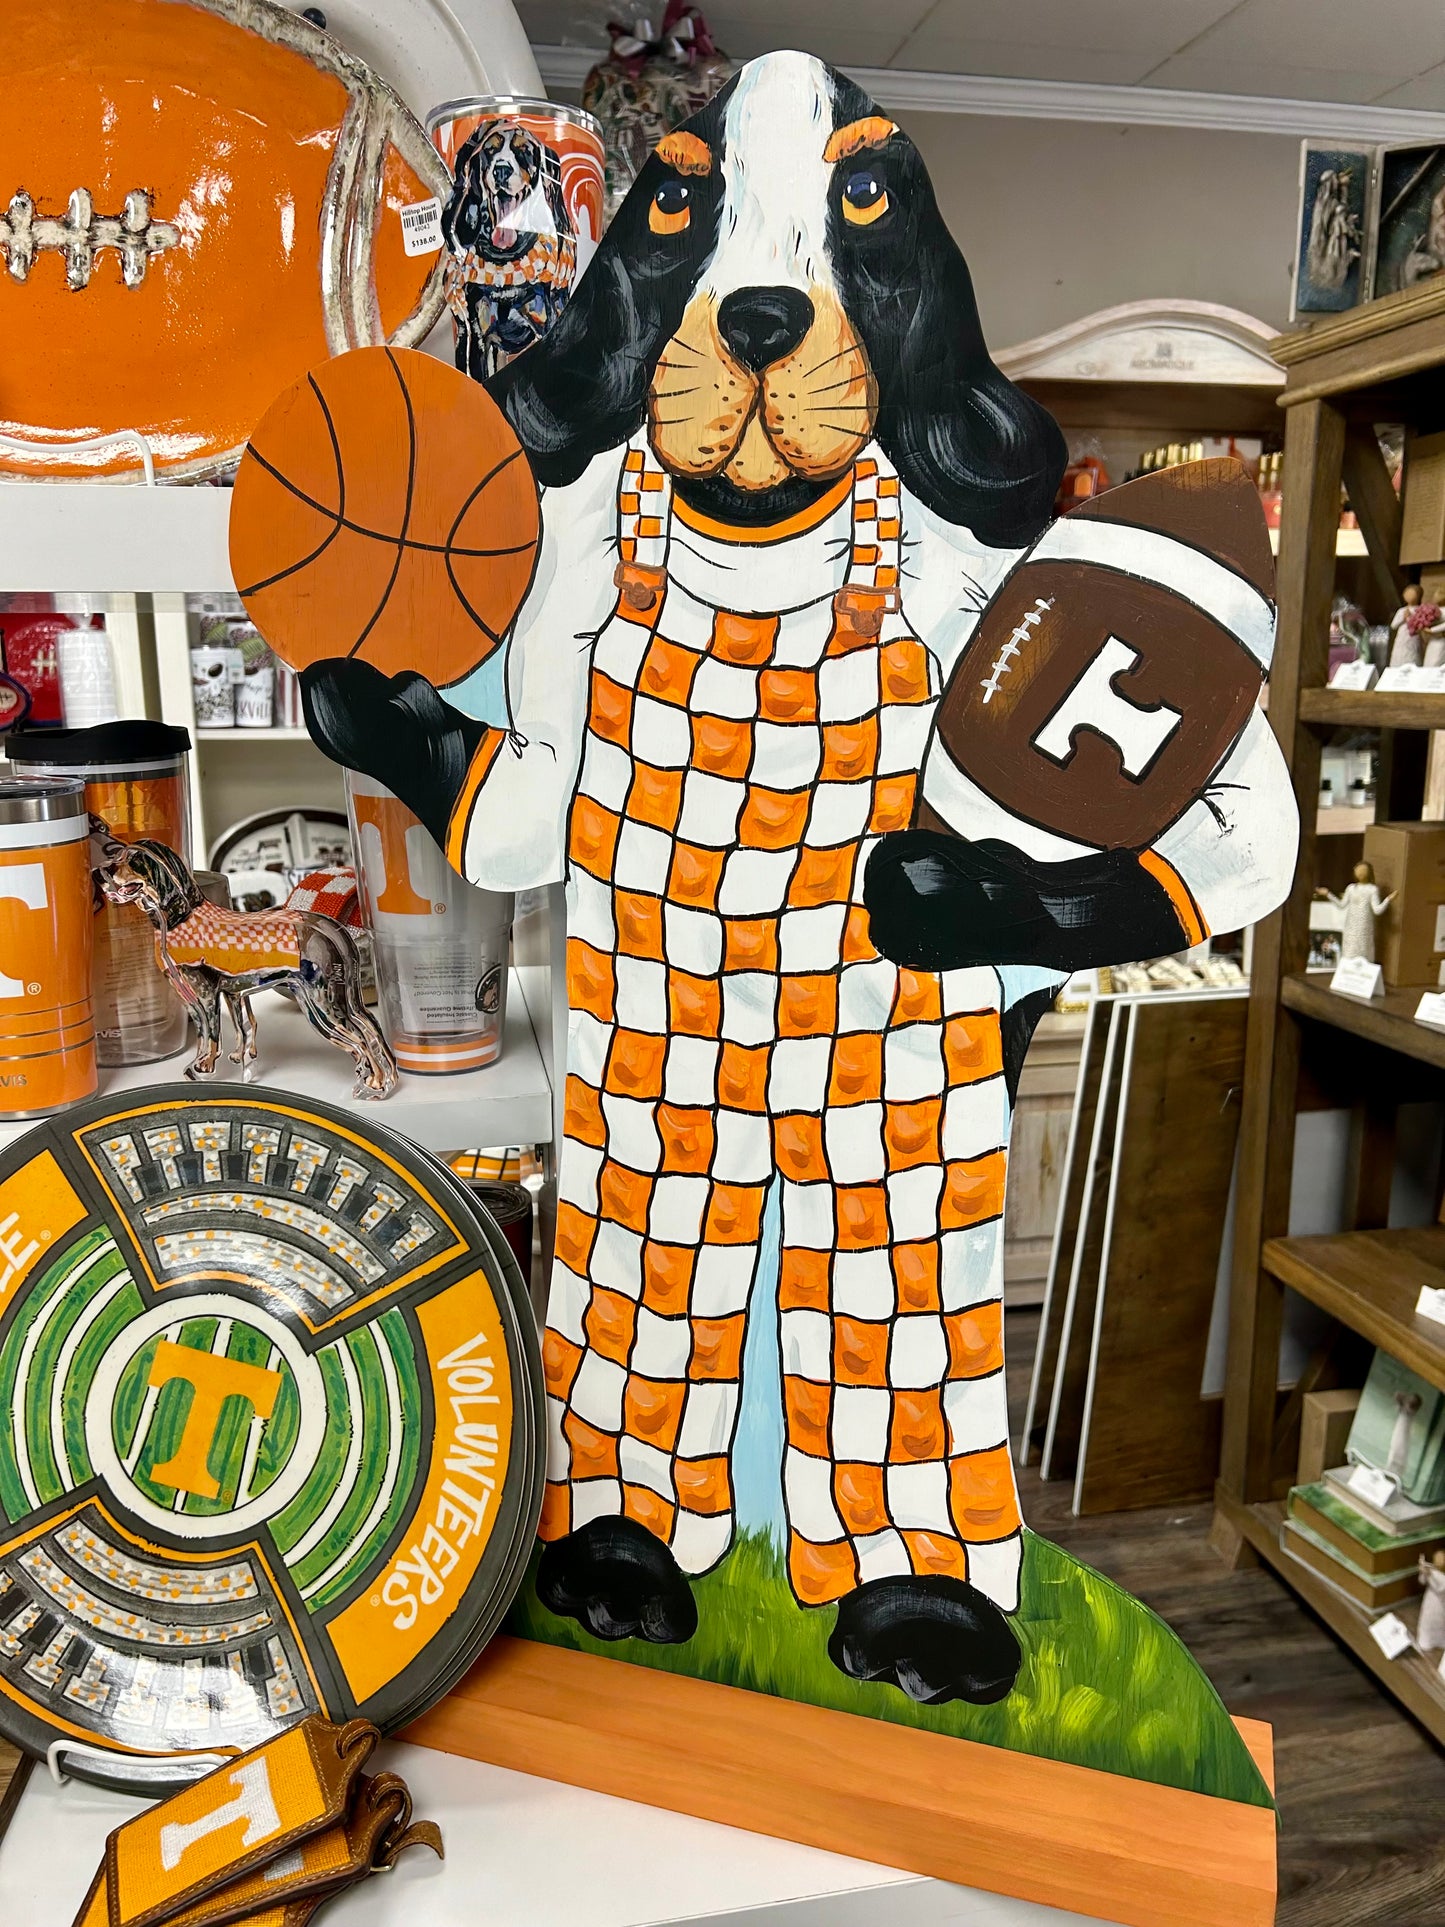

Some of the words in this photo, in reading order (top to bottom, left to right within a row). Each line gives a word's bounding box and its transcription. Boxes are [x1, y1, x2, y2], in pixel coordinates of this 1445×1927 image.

[412, 235, 436, 247] $138.00
[421, 203, 436, 211] House
[1031, 634, 1183, 781] T
[147, 1340, 283, 1499] T
[381, 1332, 500, 1630] VOLUNTEERS
[160, 1756, 281, 1872] T
